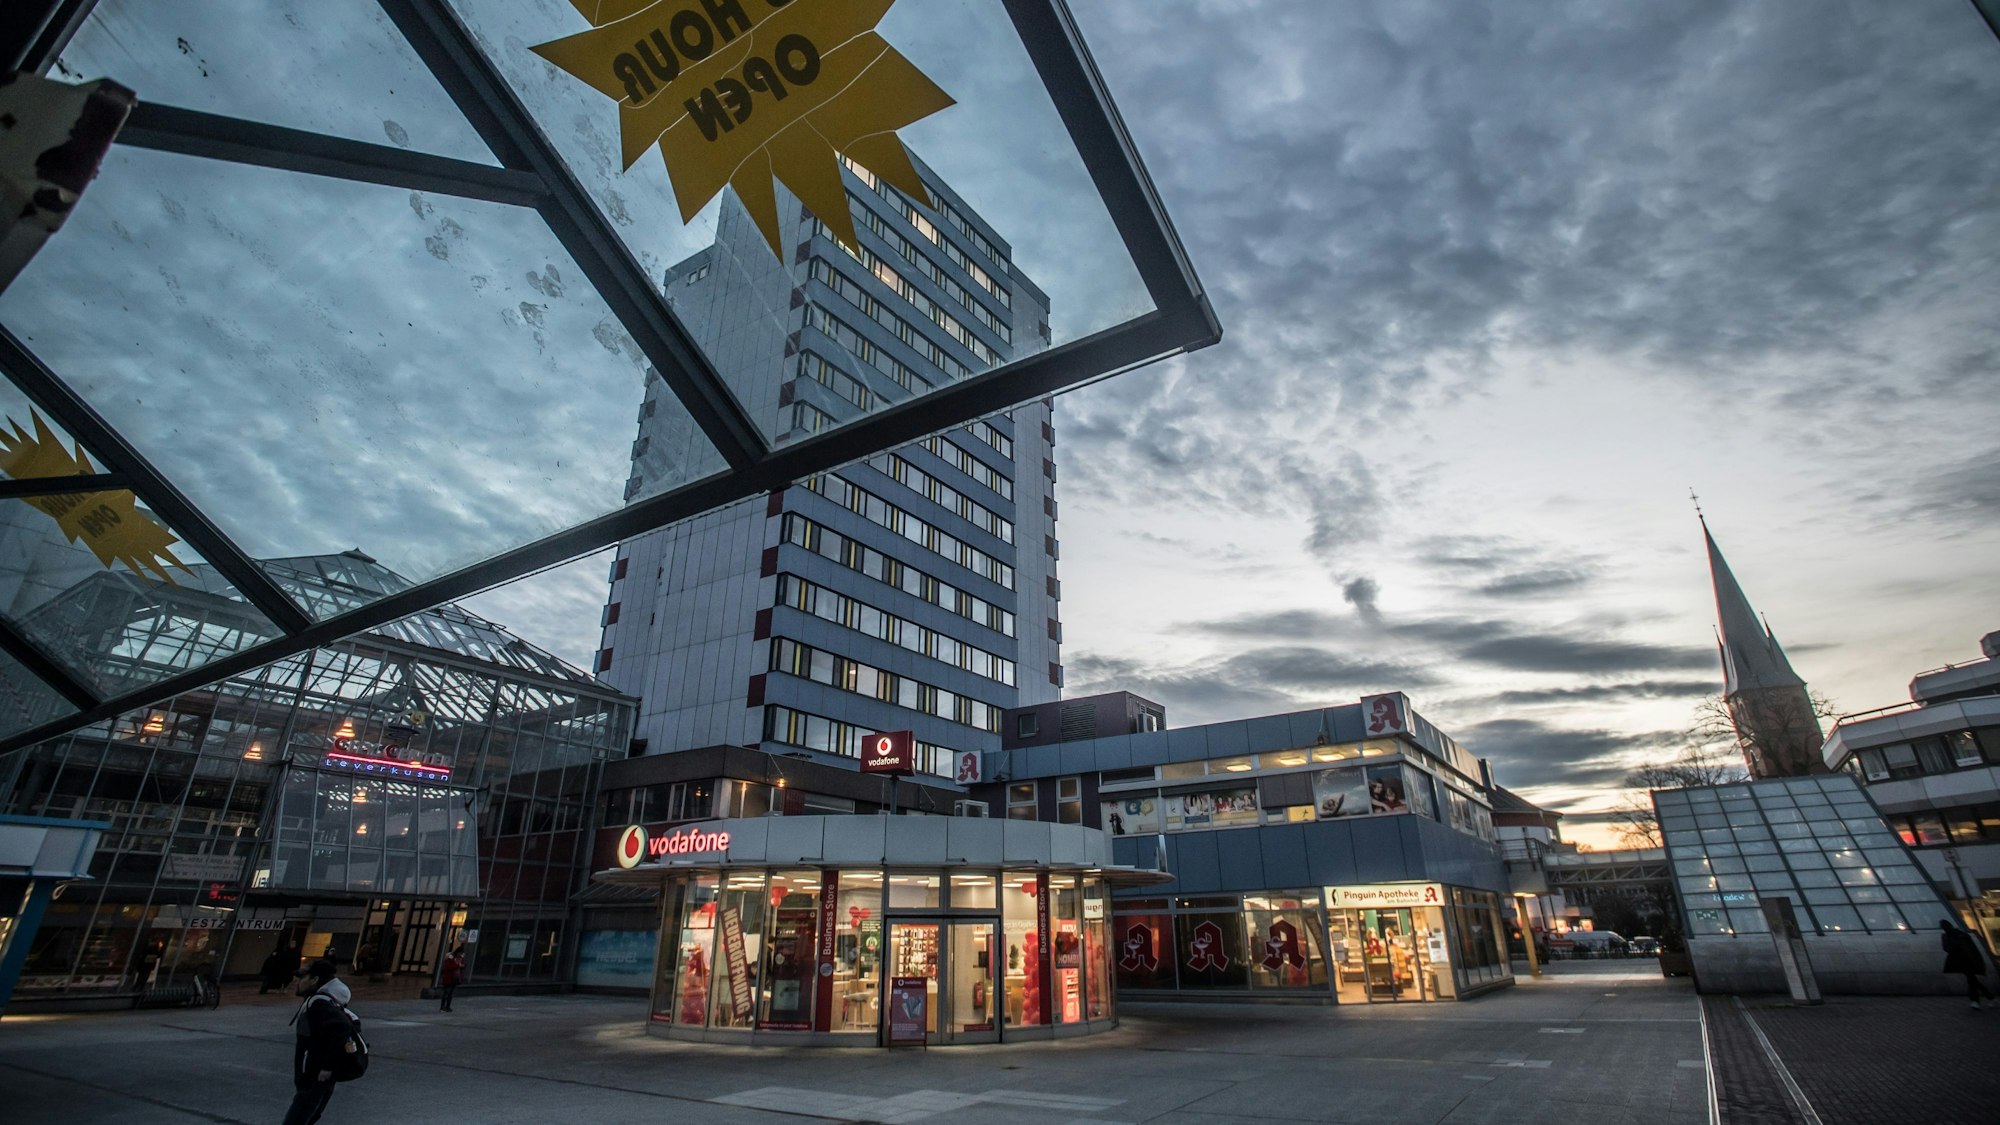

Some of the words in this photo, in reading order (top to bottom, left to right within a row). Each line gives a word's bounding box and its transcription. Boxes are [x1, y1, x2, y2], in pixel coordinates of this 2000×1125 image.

[326, 759, 448, 781] Leverkusen
[868, 757, 899, 767] vodafone
[649, 828, 730, 855] vodafone
[825, 884, 835, 909] Store
[1038, 887, 1046, 911] Store
[1344, 891, 1377, 901] Pinguin
[1378, 889, 1419, 900] Apotheke
[823, 910, 833, 955] Business
[1039, 913, 1047, 954] Business
[723, 907, 751, 1015] NEUERÖFFNUNG
